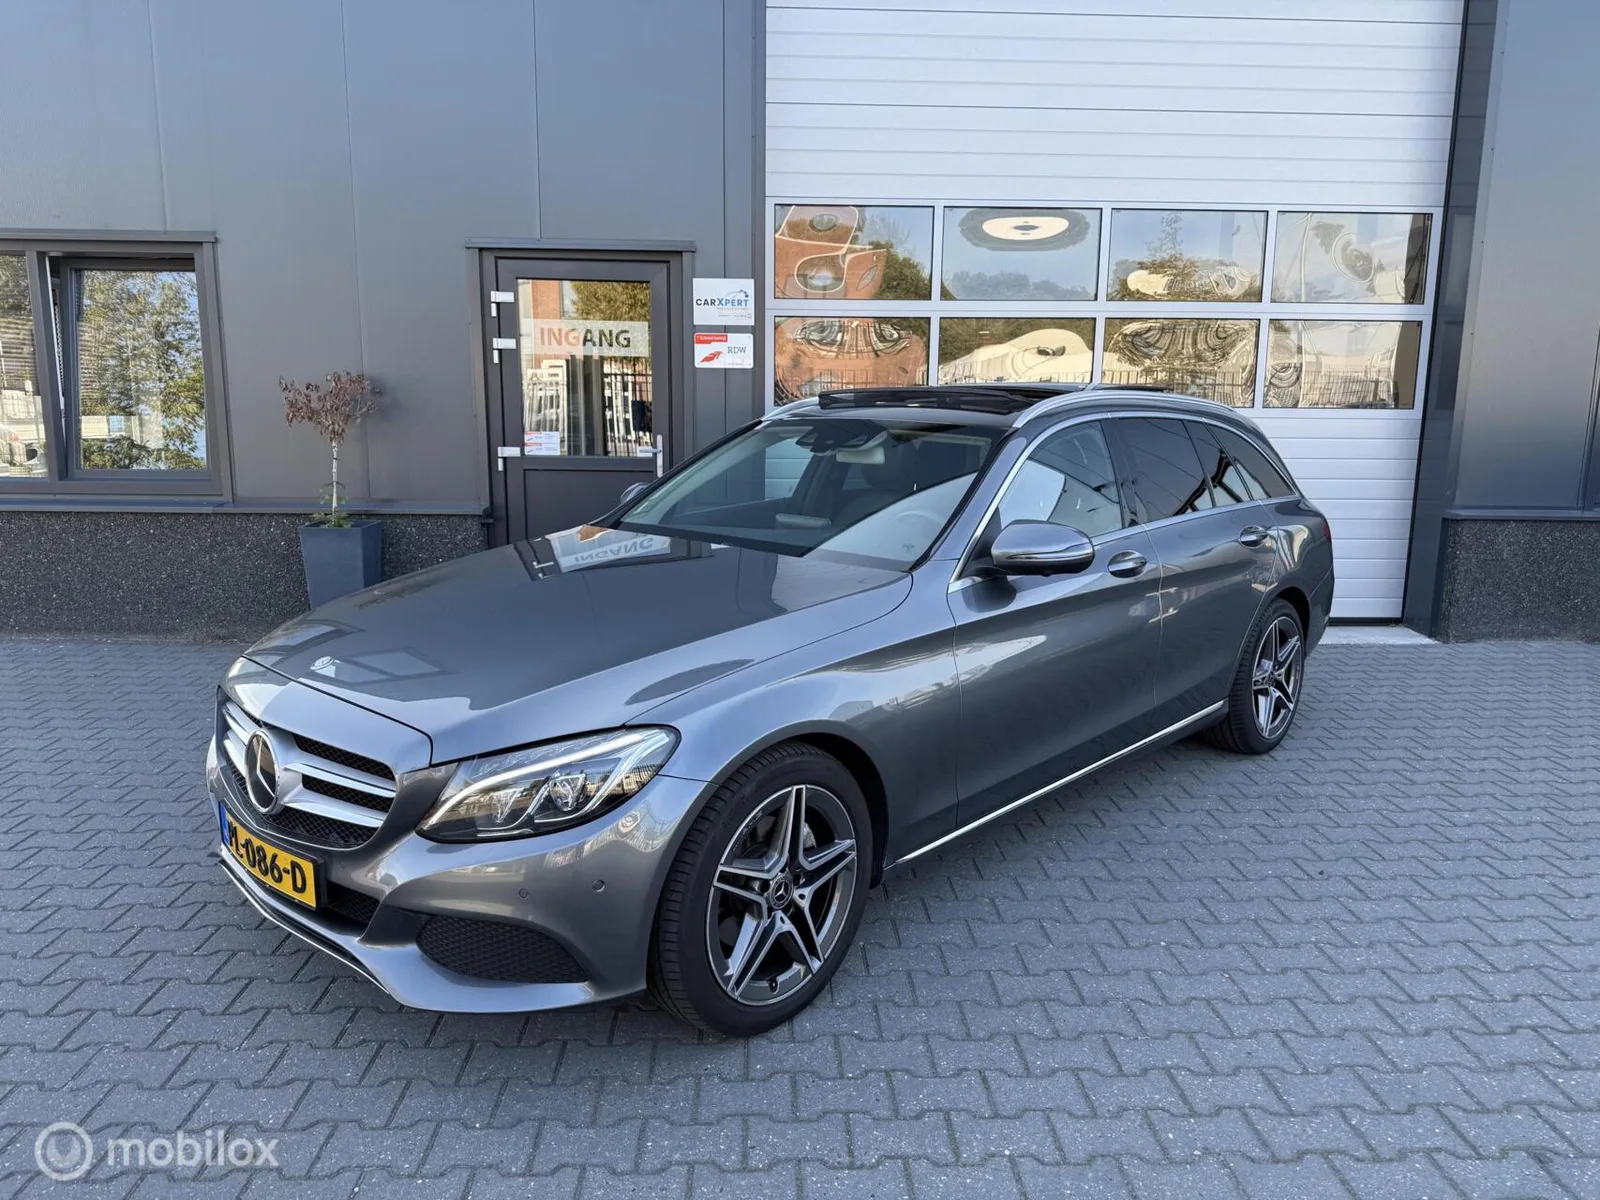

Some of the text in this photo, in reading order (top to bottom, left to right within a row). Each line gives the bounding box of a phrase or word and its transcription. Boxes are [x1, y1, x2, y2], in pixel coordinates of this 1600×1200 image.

[695, 297, 749, 306] CARXPERT
[540, 327, 631, 348] INGANG
[727, 346, 747, 354] RDW
